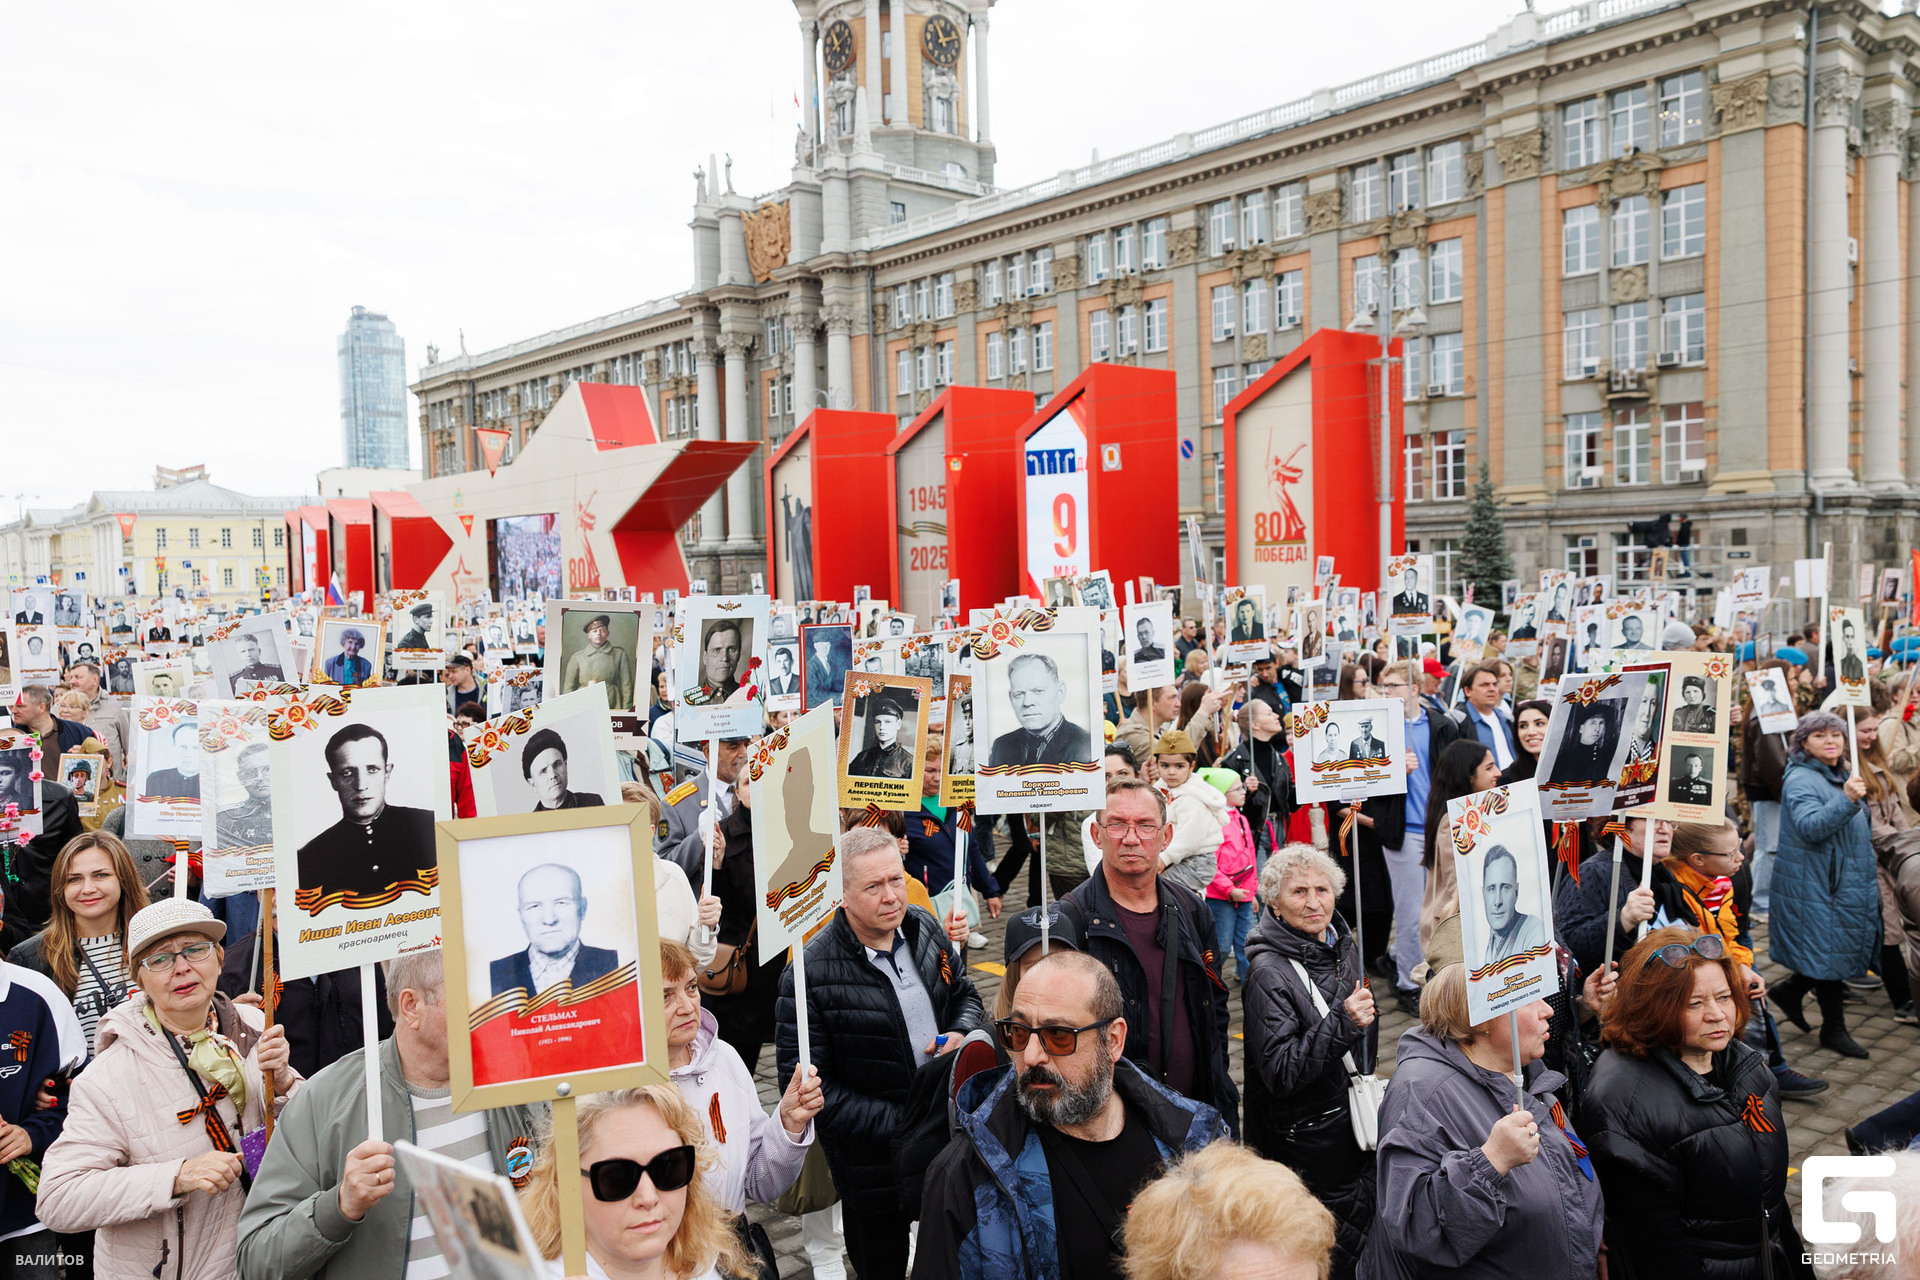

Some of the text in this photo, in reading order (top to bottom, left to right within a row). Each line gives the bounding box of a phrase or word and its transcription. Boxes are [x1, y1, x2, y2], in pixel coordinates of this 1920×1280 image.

[909, 485, 946, 512] 1945
[1052, 492, 1077, 558] 9
[1254, 511, 1282, 542] 80
[910, 545, 948, 571] 2025
[1254, 546, 1307, 564] ПОБЕДА!
[569, 557, 585, 588] 80
[848, 788, 910, 798] Александр Кузьмич
[854, 781, 905, 790] ПЕРЕПЁЛКИН
[1022, 780, 1060, 789] Коркунов
[299, 906, 441, 944] Ишин Иван Асеевич
[338, 929, 408, 950] красноармеец
[530, 1009, 578, 1024] СТЕЛЬМАХ
[510, 1018, 601, 1037] Николай Александрович
